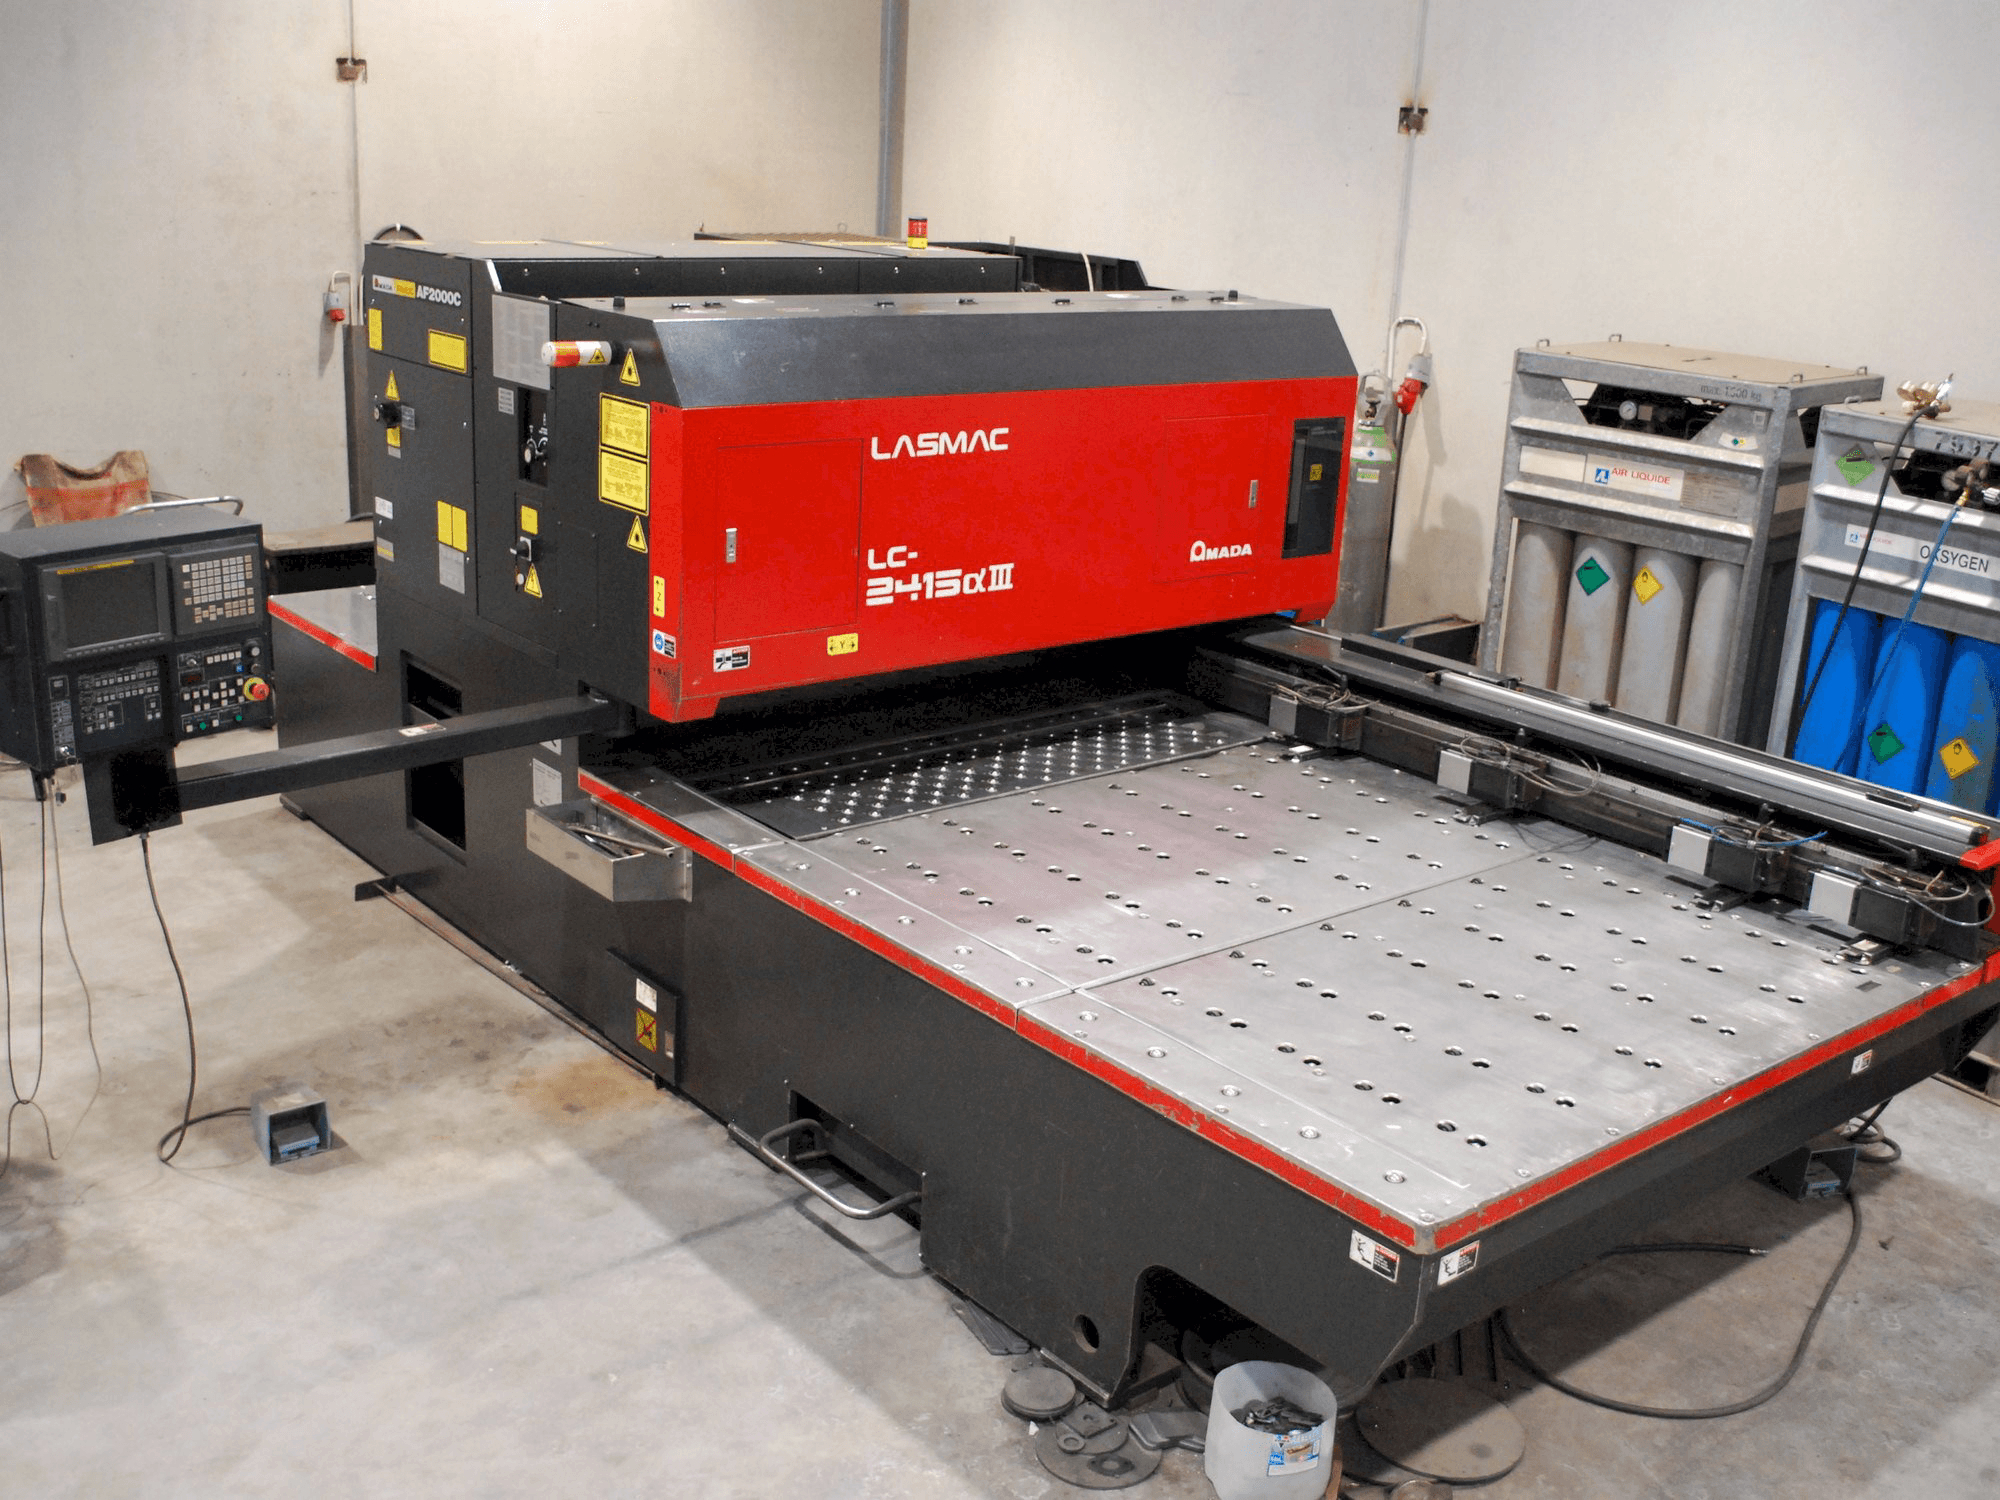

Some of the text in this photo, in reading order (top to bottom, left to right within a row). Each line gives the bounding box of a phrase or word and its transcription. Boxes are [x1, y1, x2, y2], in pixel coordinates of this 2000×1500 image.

[416, 285, 462, 307] AF2000C
[871, 427, 1009, 460] LASMAC
[1612, 467, 1671, 484] AIR LIQUIDE
[868, 545, 918, 570] LC-
[1190, 540, 1252, 562] AMADA
